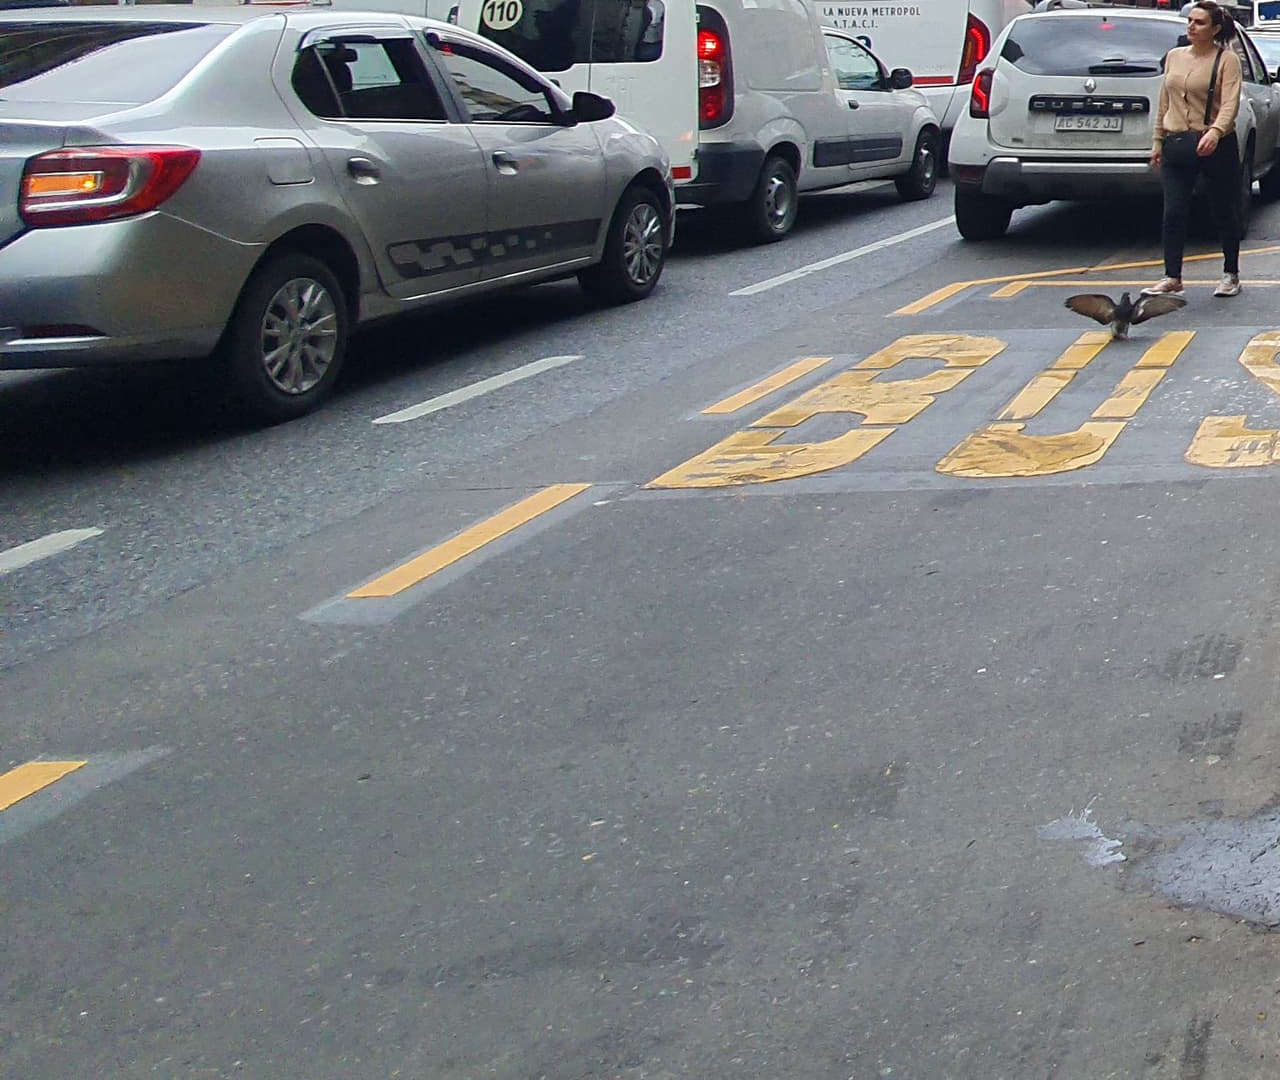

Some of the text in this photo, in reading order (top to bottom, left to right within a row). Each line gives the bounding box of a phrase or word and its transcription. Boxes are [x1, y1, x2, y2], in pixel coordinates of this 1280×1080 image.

[487, 0, 519, 22] 110
[823, 6, 921, 17] LA NUEVA METROPOL
[1076, 118, 1099, 129] 542
